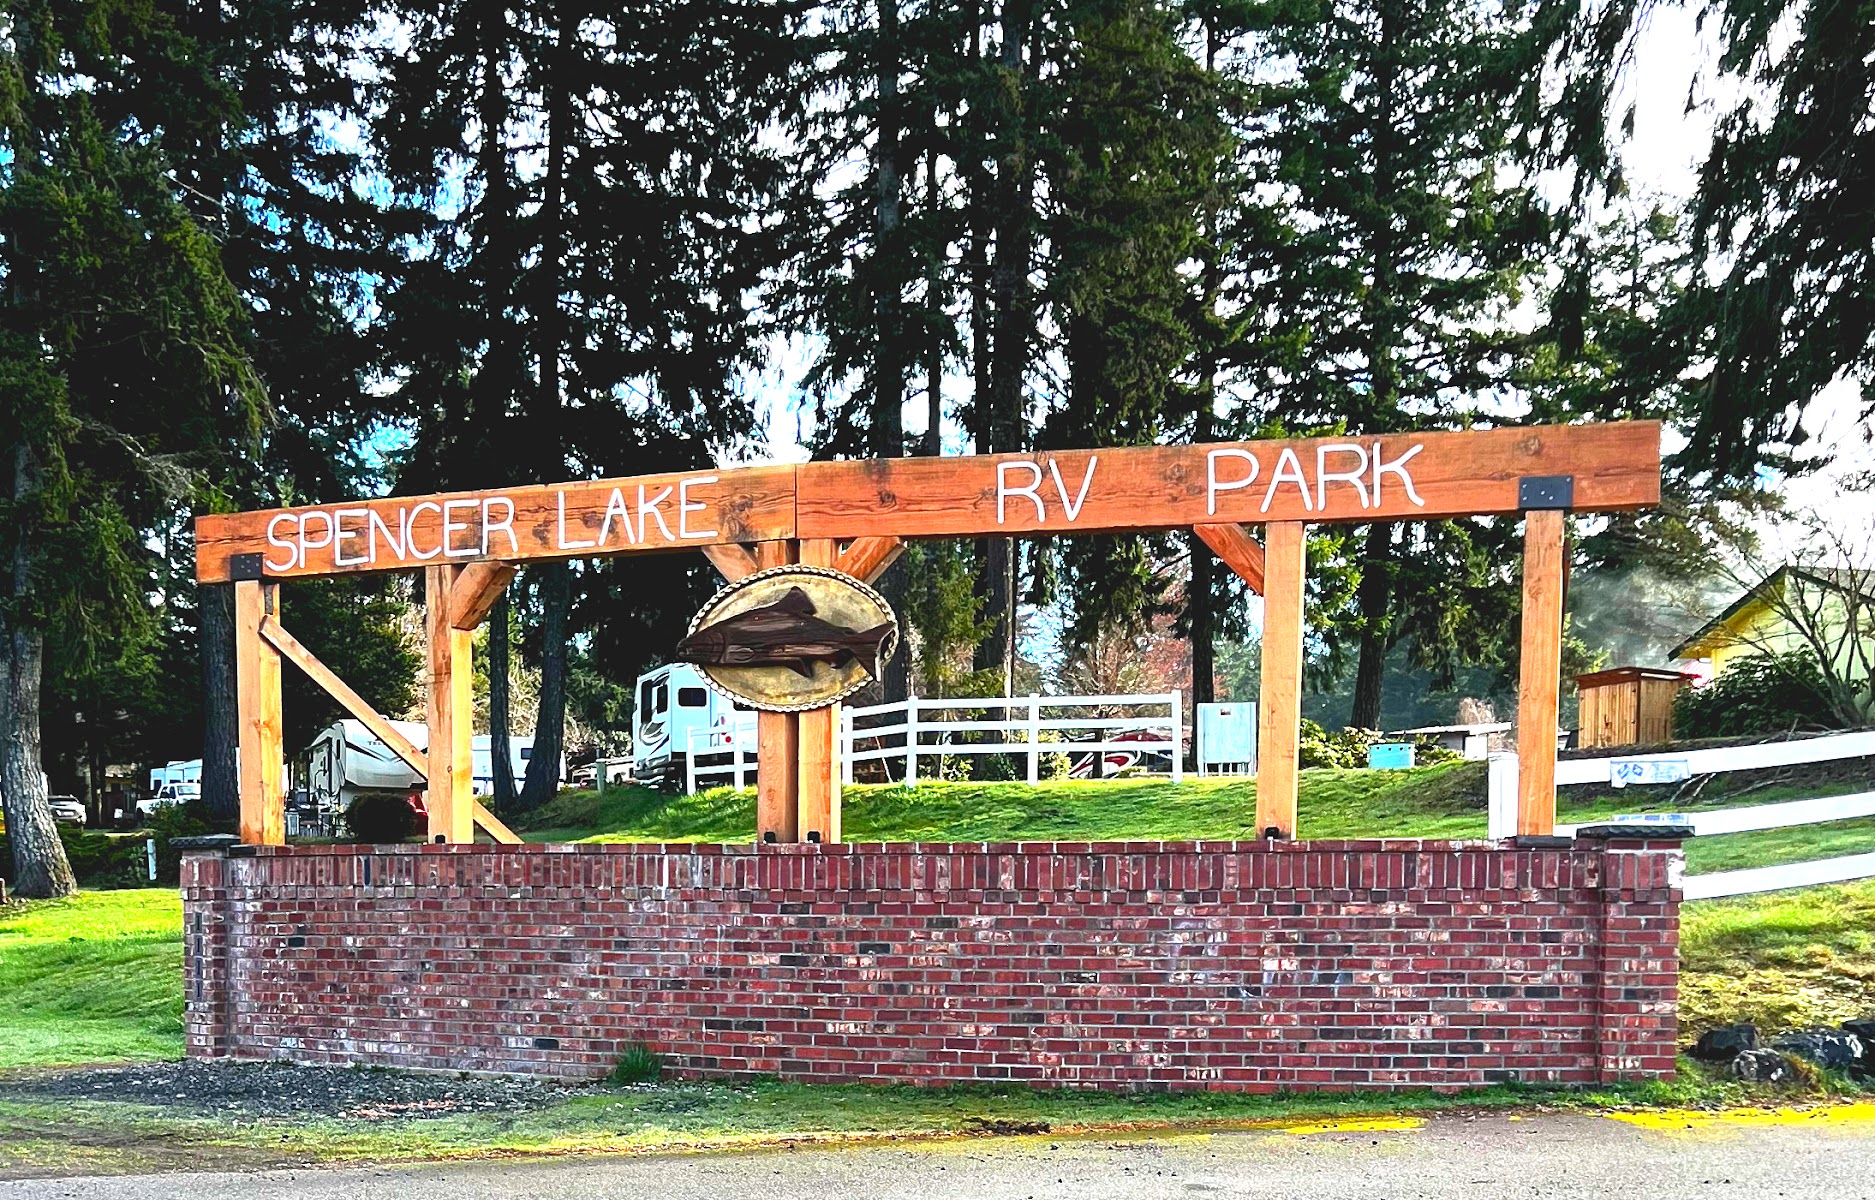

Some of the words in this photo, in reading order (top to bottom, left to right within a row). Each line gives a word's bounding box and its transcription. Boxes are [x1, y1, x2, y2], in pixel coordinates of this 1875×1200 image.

[265, 496, 519, 573] SPENCER
[557, 475, 719, 551] LAKE
[996, 455, 1098, 525] RV
[1207, 442, 1426, 516] PARK
